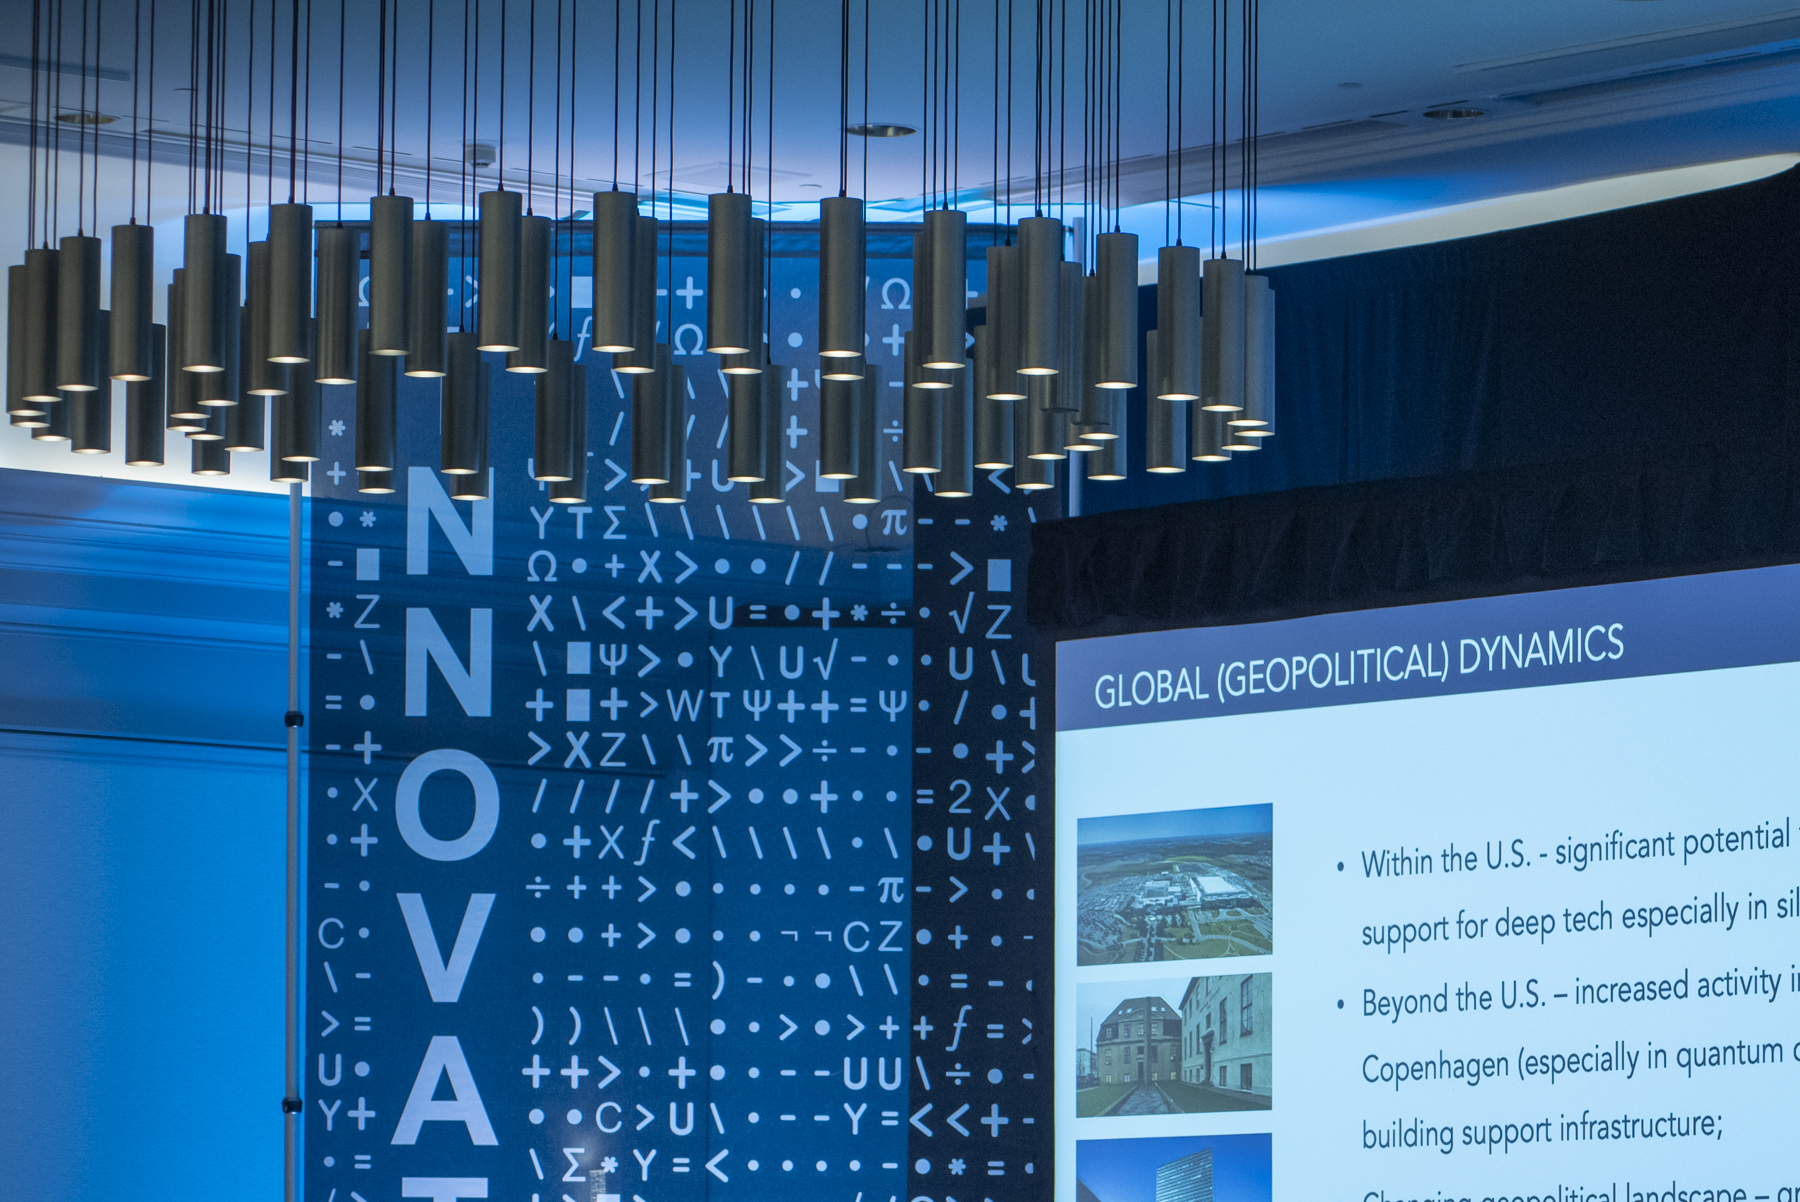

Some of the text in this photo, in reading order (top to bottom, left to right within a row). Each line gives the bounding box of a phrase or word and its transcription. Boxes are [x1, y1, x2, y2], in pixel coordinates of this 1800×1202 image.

[1094, 622, 1625, 709] GLOBAL (GEOPOLITICAL) DYNAMICS
[1361, 845, 1433, 879] Within
[1440, 842, 1478, 874] the
[1486, 838, 1531, 870] U.S.
[1555, 828, 1676, 873] significant
[1683, 816, 1790, 867] potential
[1361, 916, 1450, 955] support
[1455, 908, 1489, 940] for
[1494, 906, 1556, 946] deep
[1562, 899, 1613, 933] tech
[1621, 891, 1740, 939] especially
[1748, 891, 1768, 921] in
[1363, 982, 1448, 1024] Beyond
[1455, 980, 1493, 1012] the
[1501, 978, 1546, 1010] U.S.
[1575, 967, 1689, 1005] increased
[1697, 966, 1783, 1004] activity
[1362, 1049, 1509, 1092] Copenhagen
[1517, 1040, 1640, 1085] (especially
[1647, 1041, 1667, 1070] in
[1676, 1039, 1784, 1079] quantum
[1362, 1109, 1723, 1156] building support infrastructure;
